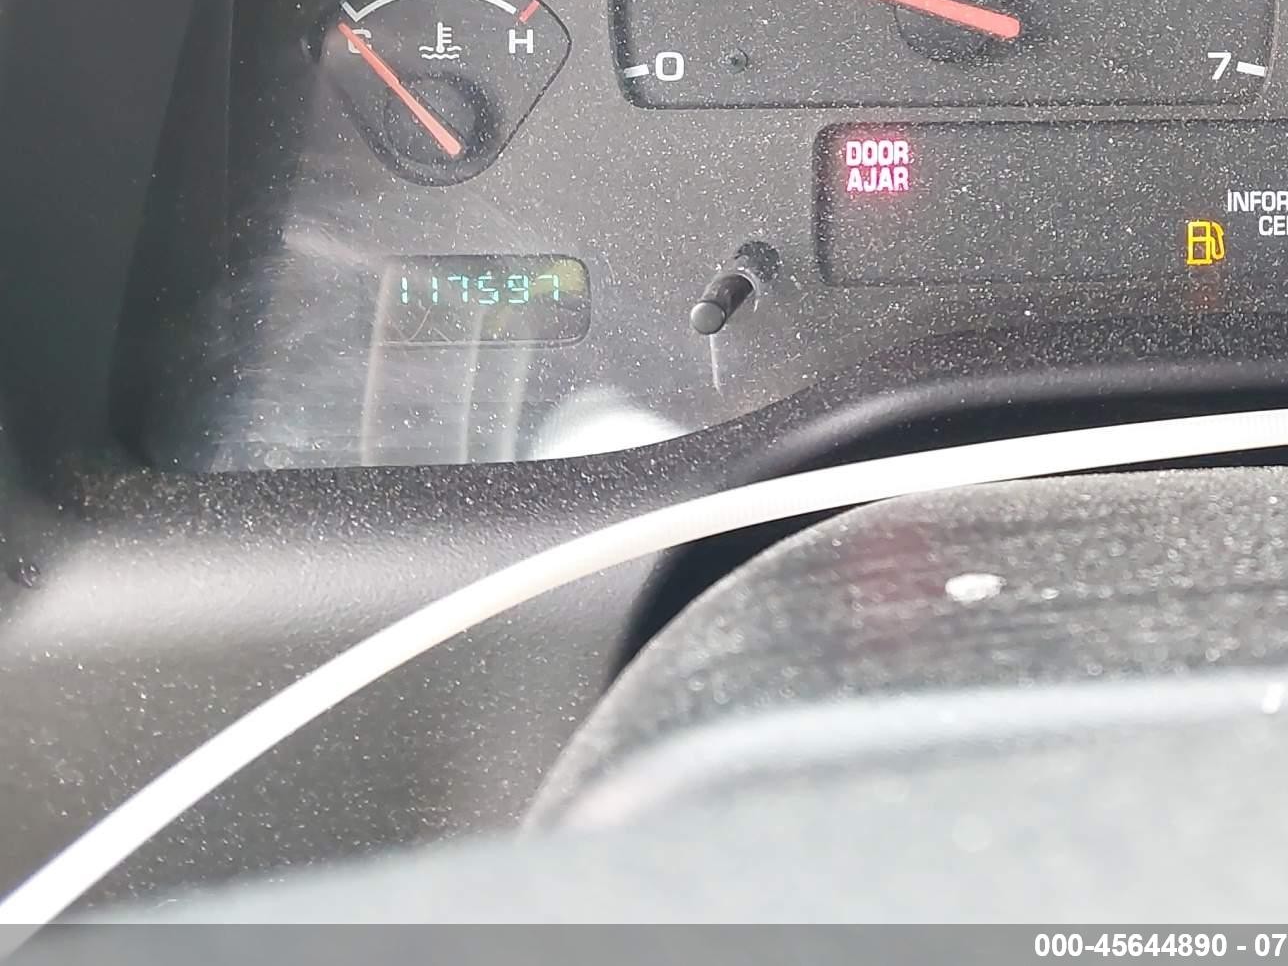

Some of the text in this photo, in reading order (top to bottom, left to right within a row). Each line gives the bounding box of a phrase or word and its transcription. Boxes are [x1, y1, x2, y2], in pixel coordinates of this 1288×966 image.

[508, 28, 534, 54] H
[655, 51, 685, 82] 0
[1207, 51, 1232, 80] 7
[845, 141, 909, 166] DOOR
[845, 167, 909, 192] AJAR
[401, 274, 560, 304] 117597
